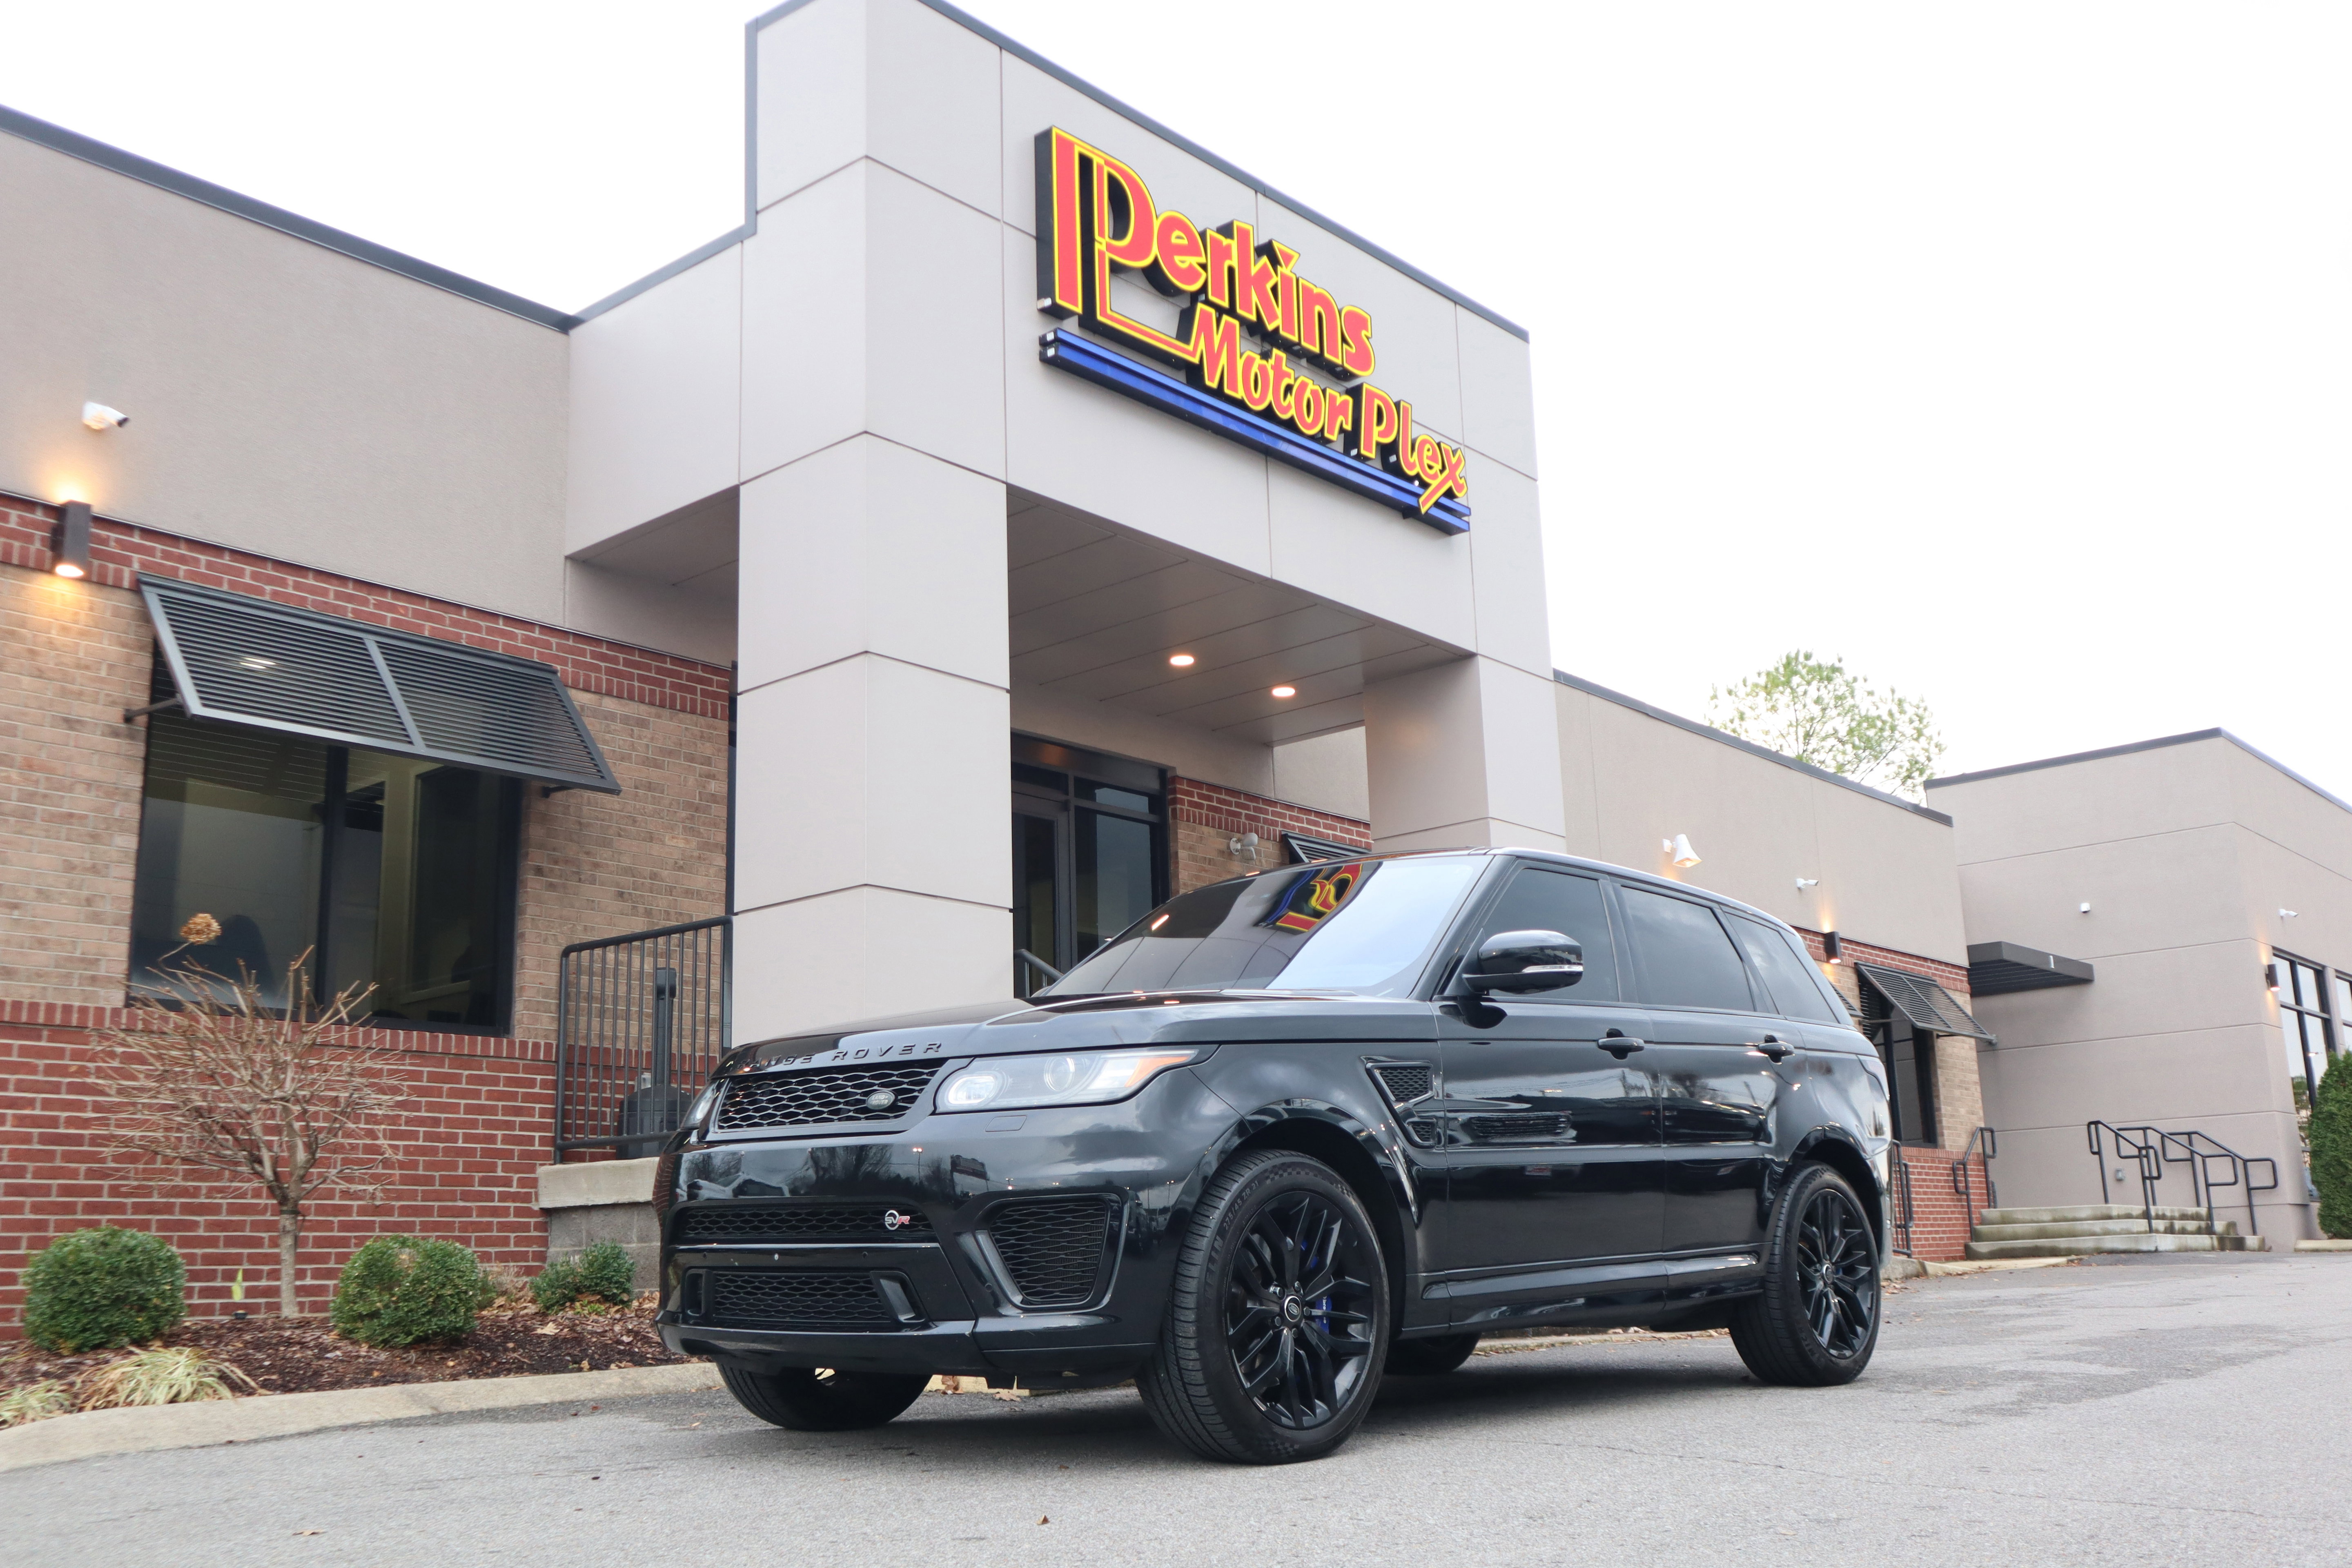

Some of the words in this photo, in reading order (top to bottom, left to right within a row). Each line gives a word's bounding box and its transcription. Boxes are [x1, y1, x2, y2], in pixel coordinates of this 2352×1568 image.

[1051, 125, 1376, 376] Perkins
[1192, 303, 1354, 443] Motor
[1361, 382, 1468, 514] Plex
[737, 1052, 817, 1069] RANGE
[831, 1042, 941, 1061] ROVER
[1223, 1198, 1242, 1231] 275/45
[1242, 1187, 1252, 1200] ZR
[1252, 1179, 1259, 1191] 21
